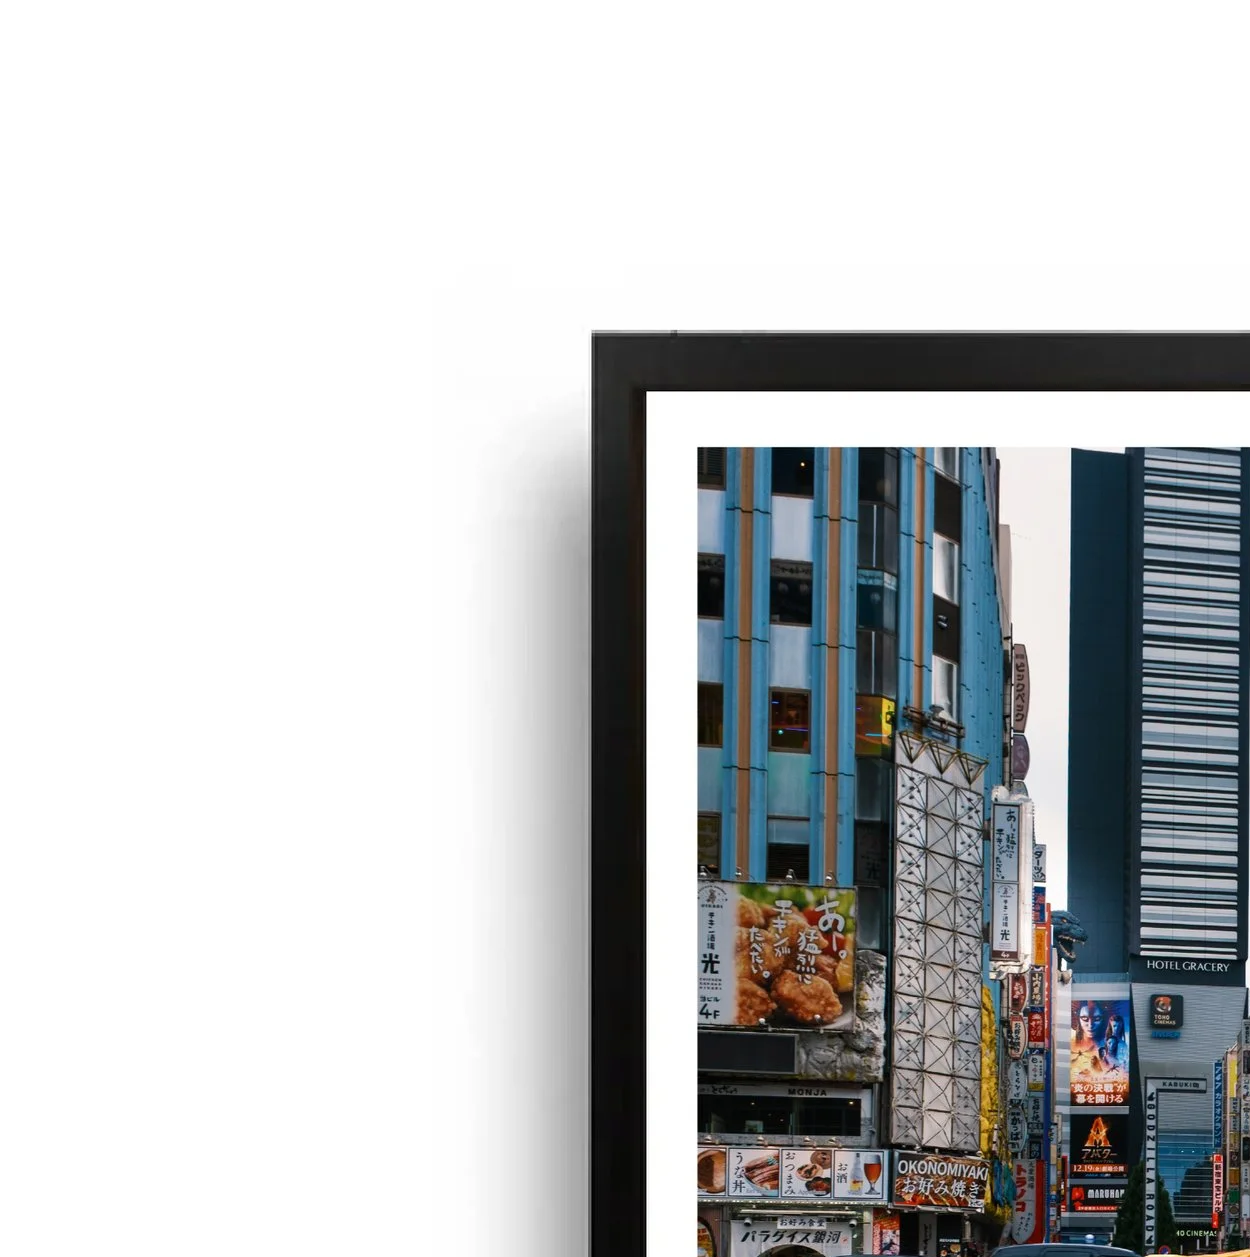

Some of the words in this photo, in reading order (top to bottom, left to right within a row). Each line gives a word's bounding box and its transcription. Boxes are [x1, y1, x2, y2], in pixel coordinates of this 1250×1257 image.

[1000, 929, 1011, 942] 光
[701, 953, 721, 975] 光
[797, 929, 823, 985] 猛烈に
[1146, 959, 1181, 970] HOTEL
[1182, 961, 1230, 972] GRACERY
[698, 1003, 721, 1020] 4F
[788, 1088, 827, 1096] MONJA
[1076, 1094, 1124, 1104] 幕を開ける
[1082, 1148, 1118, 1160] アバター
[1147, 1103, 1156, 1184] GODZILLA
[785, 1152, 796, 1195] おつまみ
[836, 1163, 848, 1184] お酒
[897, 1160, 989, 1181] OKONOMIYAKI
[902, 1176, 980, 1199] お好み焼き
[1015, 1164, 1027, 1213] トラノコ
[780, 1218, 826, 1227] お好み食堂
[1146, 1194, 1155, 1232] ROAD
